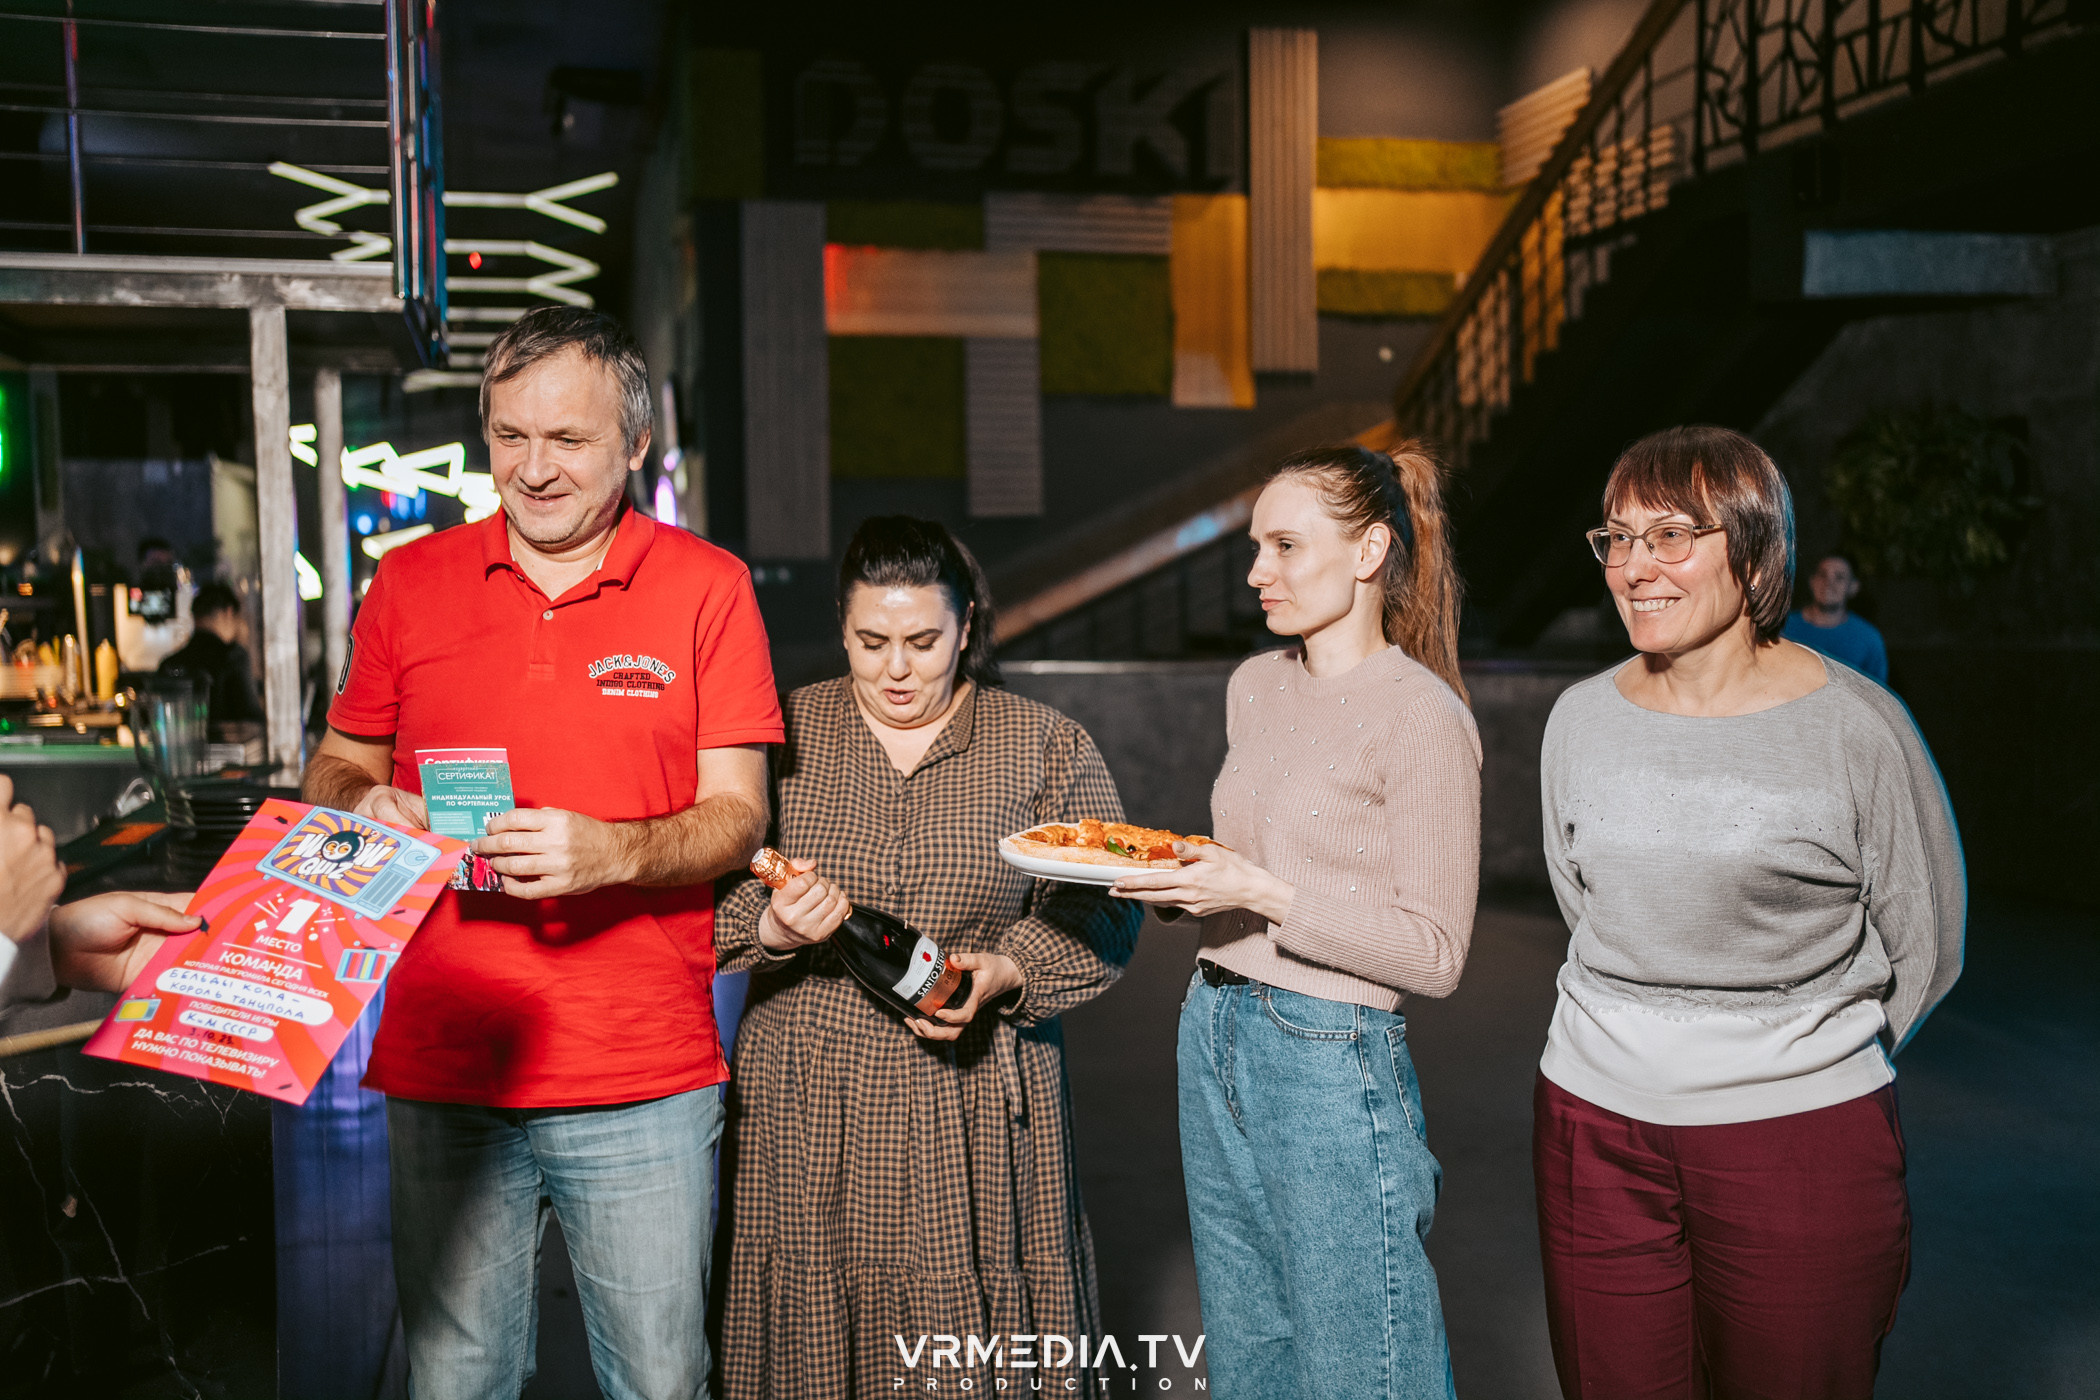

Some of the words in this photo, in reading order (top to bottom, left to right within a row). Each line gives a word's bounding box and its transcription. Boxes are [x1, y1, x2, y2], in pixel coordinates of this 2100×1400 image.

[793, 56, 1234, 178] DOSKI
[588, 654, 676, 684] JACK&JONES
[613, 672, 651, 680] CRAFTED
[596, 679, 623, 688] INDIGO
[626, 681, 665, 691] CLOTHING
[602, 688, 625, 696] DENIM
[626, 689, 659, 699] CLOTHING
[438, 772, 495, 781] СЕРТИФИКАТ
[431, 793, 493, 801] ИНДИВИДУАЛЬНЫЙ
[297, 857, 354, 880] QUIZ
[275, 898, 321, 934] 1
[256, 935, 302, 952] МЕСТО
[184, 960, 220, 972] КОТОРАЯ
[220, 966, 270, 983] РАЗГРОМИЛА
[271, 978, 308, 993] СЕГОДНЯ
[307, 988, 329, 998] ВСЕХ
[219, 951, 303, 980] КОМАНДА
[243, 983, 285, 1000] КОЛА
[917, 970, 939, 997] SANTO
[170, 982, 222, 999] КОРОЛЬ
[232, 994, 304, 1019] ТАНЦПОЛА
[189, 1001, 252, 1021] ПОБЕДИТЕЛИ
[252, 1014, 280, 1028] ИГРЫ
[222, 1023, 257, 1037] СССР
[131, 1040, 180, 1058] НУЖНО
[178, 1050, 268, 1079] ПОКАЗЫВАТЬ!
[133, 1028, 153, 1039] ДА
[154, 1031, 180, 1044] ВАС
[178, 1036, 199, 1048] ПО
[199, 1041, 280, 1068] ТЕЛЕВИЗИРУ
